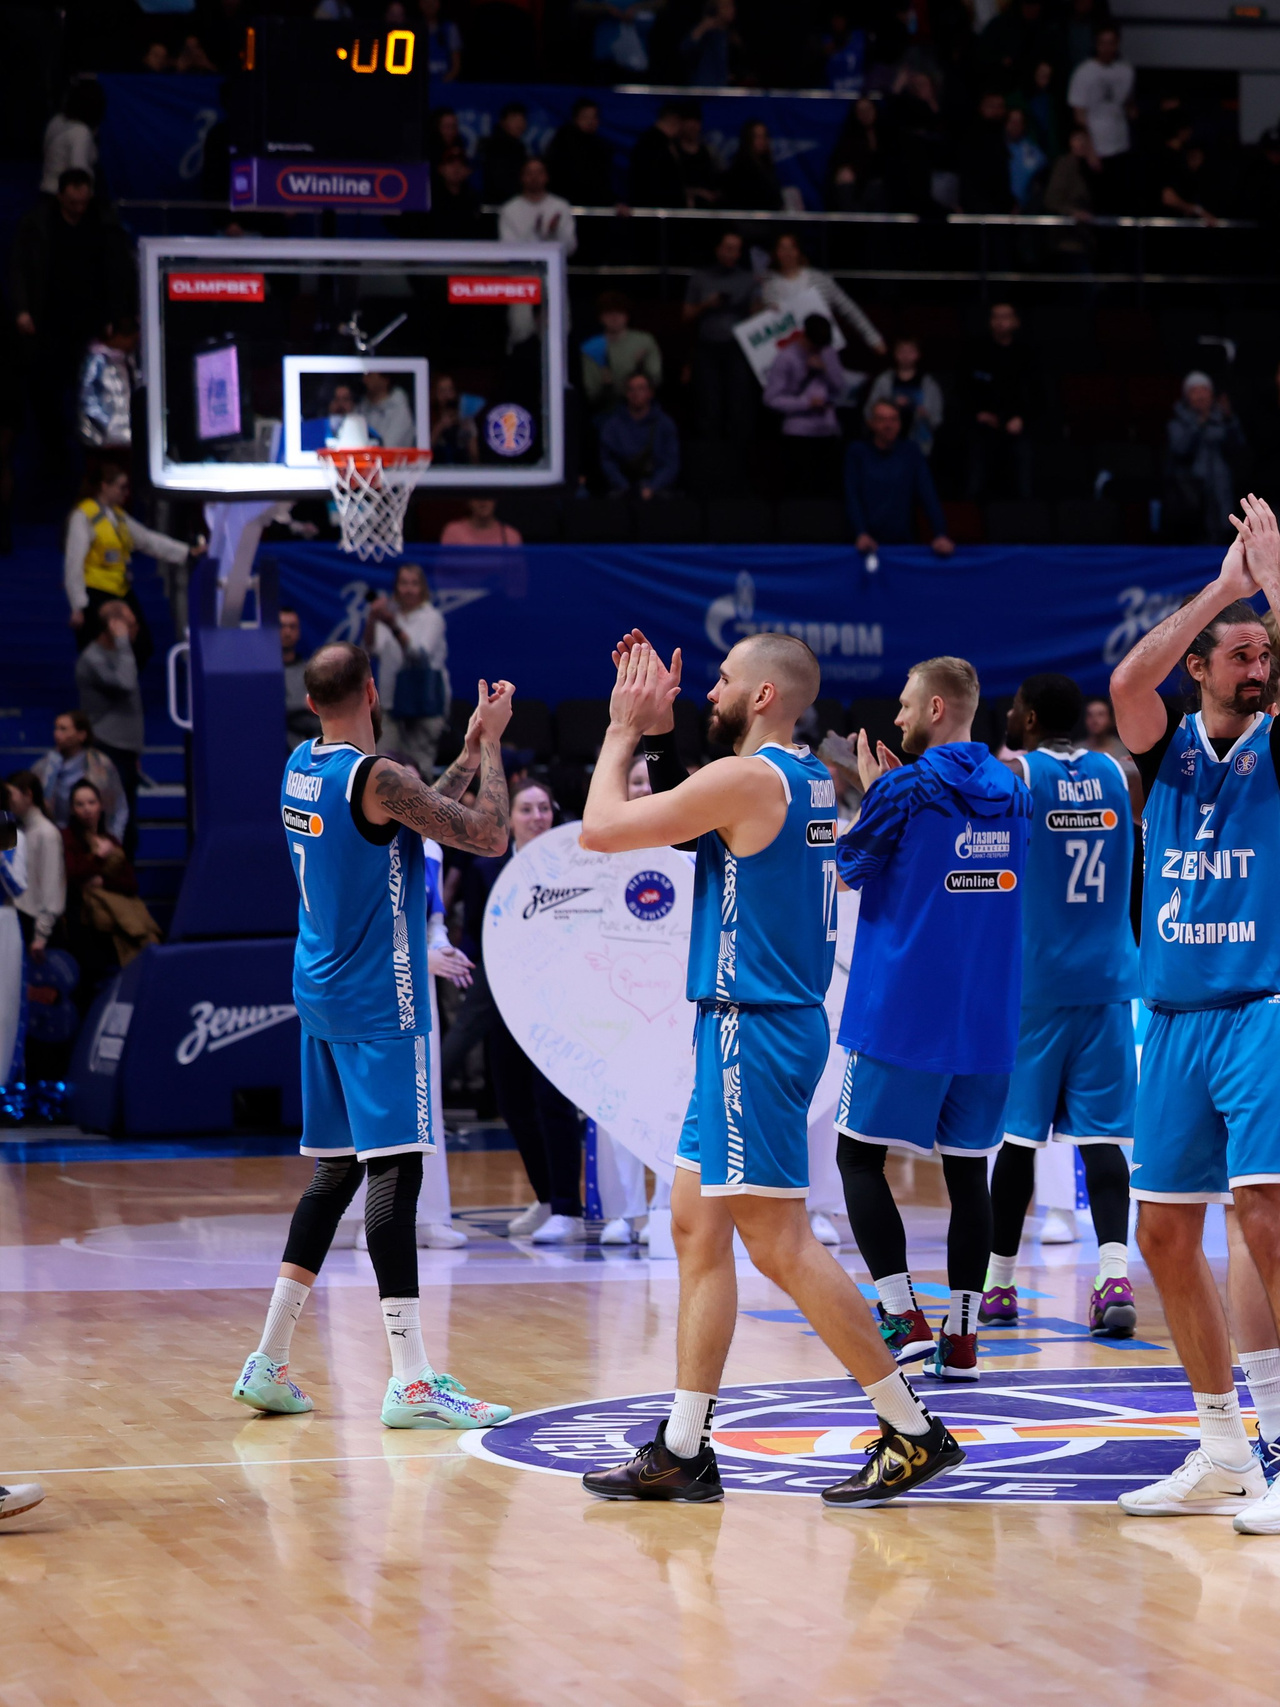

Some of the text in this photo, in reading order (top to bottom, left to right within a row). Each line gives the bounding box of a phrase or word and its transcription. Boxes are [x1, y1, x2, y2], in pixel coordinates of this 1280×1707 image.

[287, 174, 371, 196] Winline
[172, 280, 260, 295] OLIMPBET
[451, 283, 536, 298] OLIMPBET
[285, 770, 324, 803] KARASEV
[1057, 778, 1104, 803] BACON
[284, 810, 308, 831] Winline
[1052, 814, 1099, 828] Winline
[1195, 802, 1216, 840] 2
[809, 826, 833, 842] Winline
[972, 831, 1010, 845] ГАЗПРОМ
[1065, 839, 1106, 904] 24
[1161, 848, 1256, 880] ZENIT
[293, 841, 311, 913] 7
[951, 875, 995, 888] Winline
[522, 885, 595, 920] Зенит
[821, 859, 837, 942] 12
[1178, 920, 1256, 944] ГАЗПРОМ
[176, 1002, 300, 1065] Зенит
